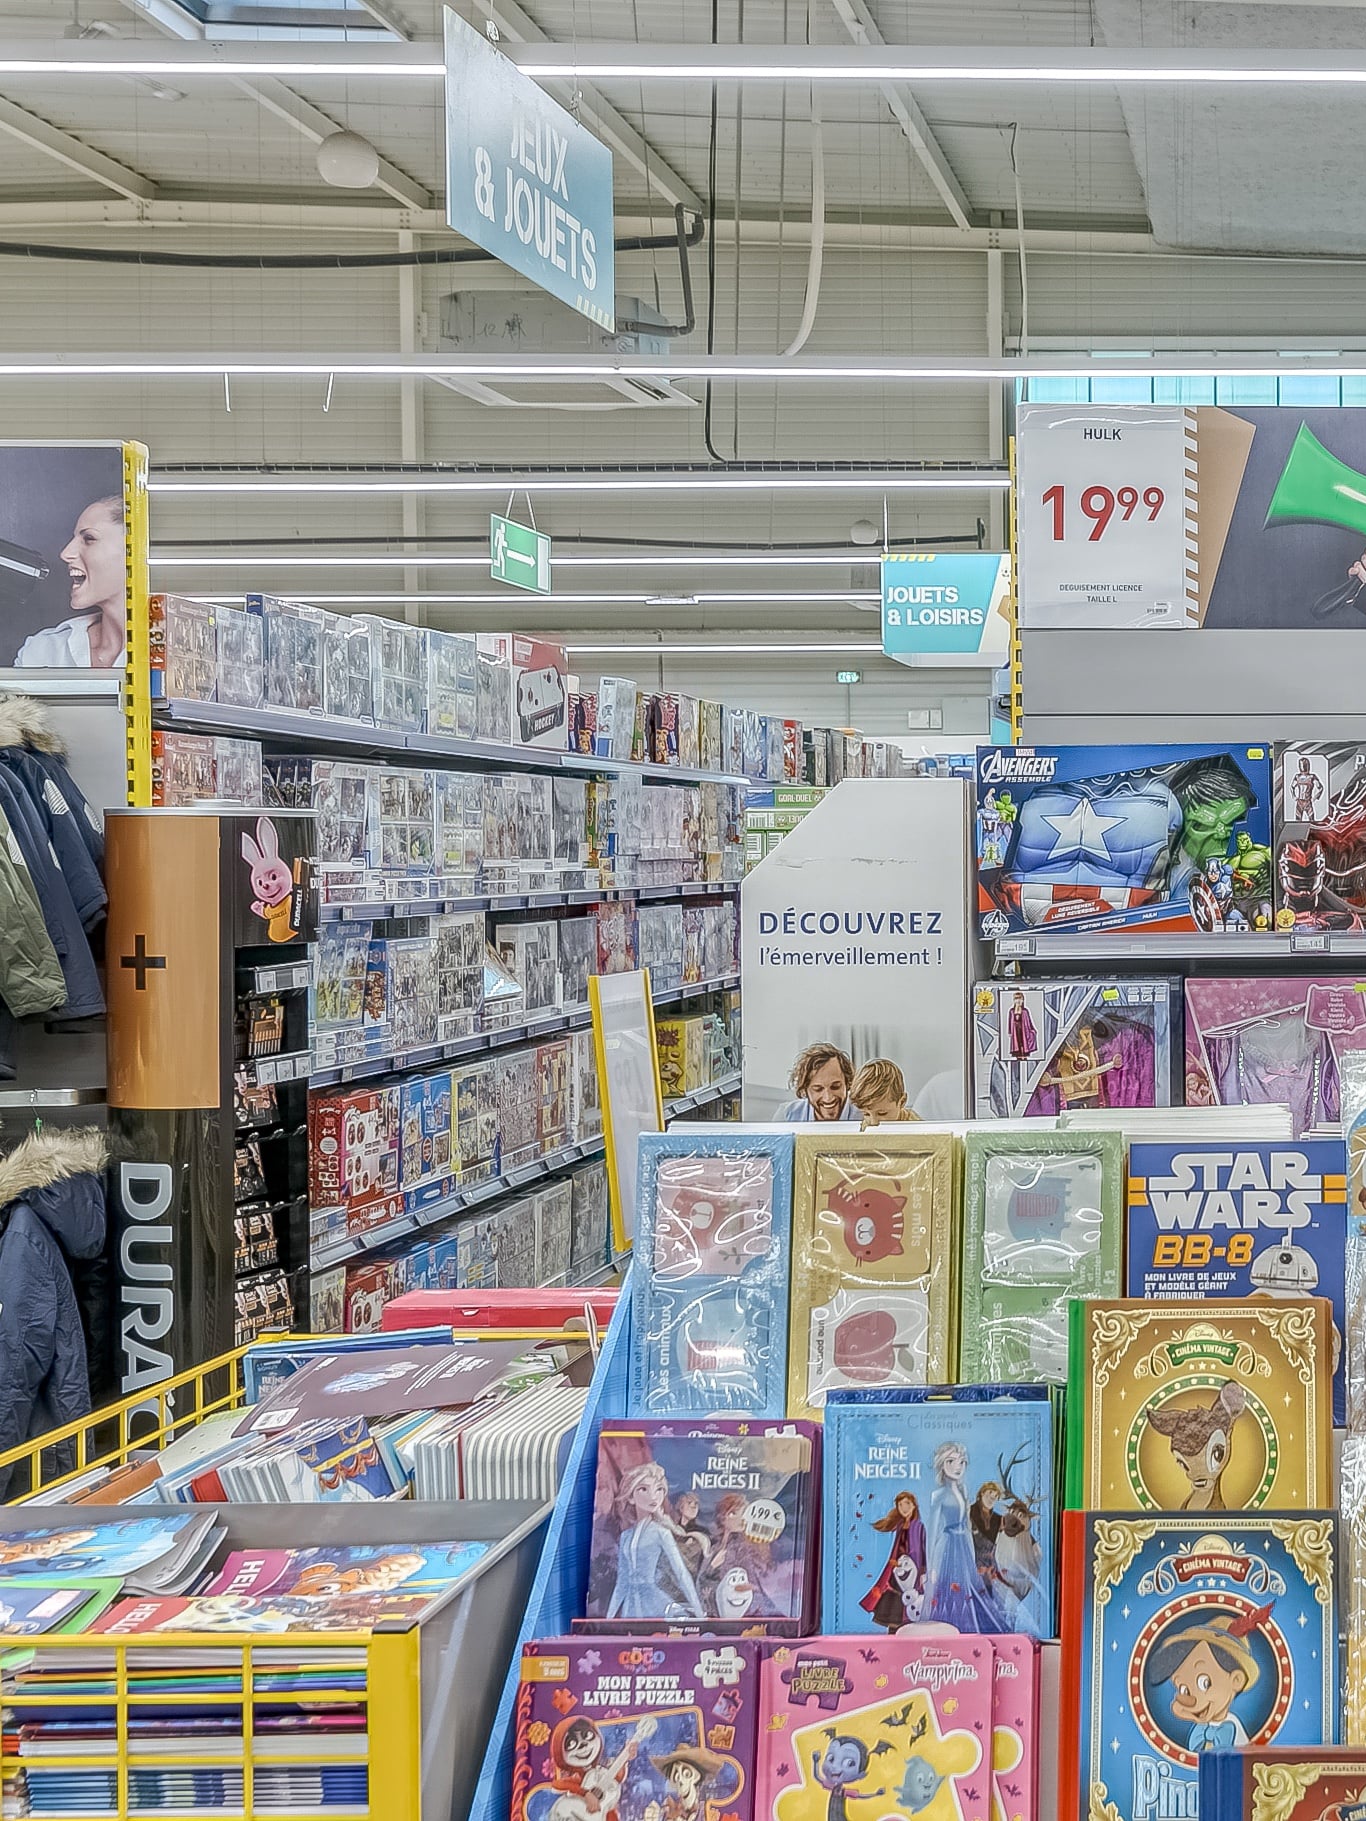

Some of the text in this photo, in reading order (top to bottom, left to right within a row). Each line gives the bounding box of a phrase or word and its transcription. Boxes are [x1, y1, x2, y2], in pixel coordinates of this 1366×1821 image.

[511, 112, 569, 201] JEUX
[474, 147, 597, 290] & JOUETS
[1083, 428, 1122, 441] HULK
[887, 586, 959, 604] JOUETS
[1059, 584, 1143, 592] DEGUISEMENT LICENCE
[1087, 596, 1111, 604] TAILLE
[887, 608, 984, 626] & LOISIRS
[981, 749, 1058, 783] AVENGERS
[759, 906, 943, 936] DÉCOUVREZ
[759, 947, 930, 968] l'émerveillement
[1149, 1152, 1321, 1190] STAR
[1149, 1190, 1321, 1229] WARS
[1153, 1234, 1255, 1268] BB-8
[1145, 1272, 1236, 1281] MON LIVRE DE JEUX
[1145, 1282, 1156, 1290] ET
[1158, 1281, 1196, 1290] MODÈLE
[1175, 1343, 1230, 1357] CINÉMA VINTAGE
[907, 1414, 973, 1432] Classiques
[868, 1446, 908, 1461] REINE
[707, 1457, 748, 1471] REINE
[854, 1463, 907, 1480] NEIGES
[691, 1473, 746, 1490] NEIGES
[750, 1505, 770, 1520] 1,99
[1182, 1559, 1243, 1574] CINÉMA VINTAGE
[801, 1667, 839, 1680] LIVRE
[597, 1675, 680, 1690] MON PETIT
[792, 1678, 845, 1692] PUZZLE
[583, 1690, 695, 1706] LIVRE PUZZLE
